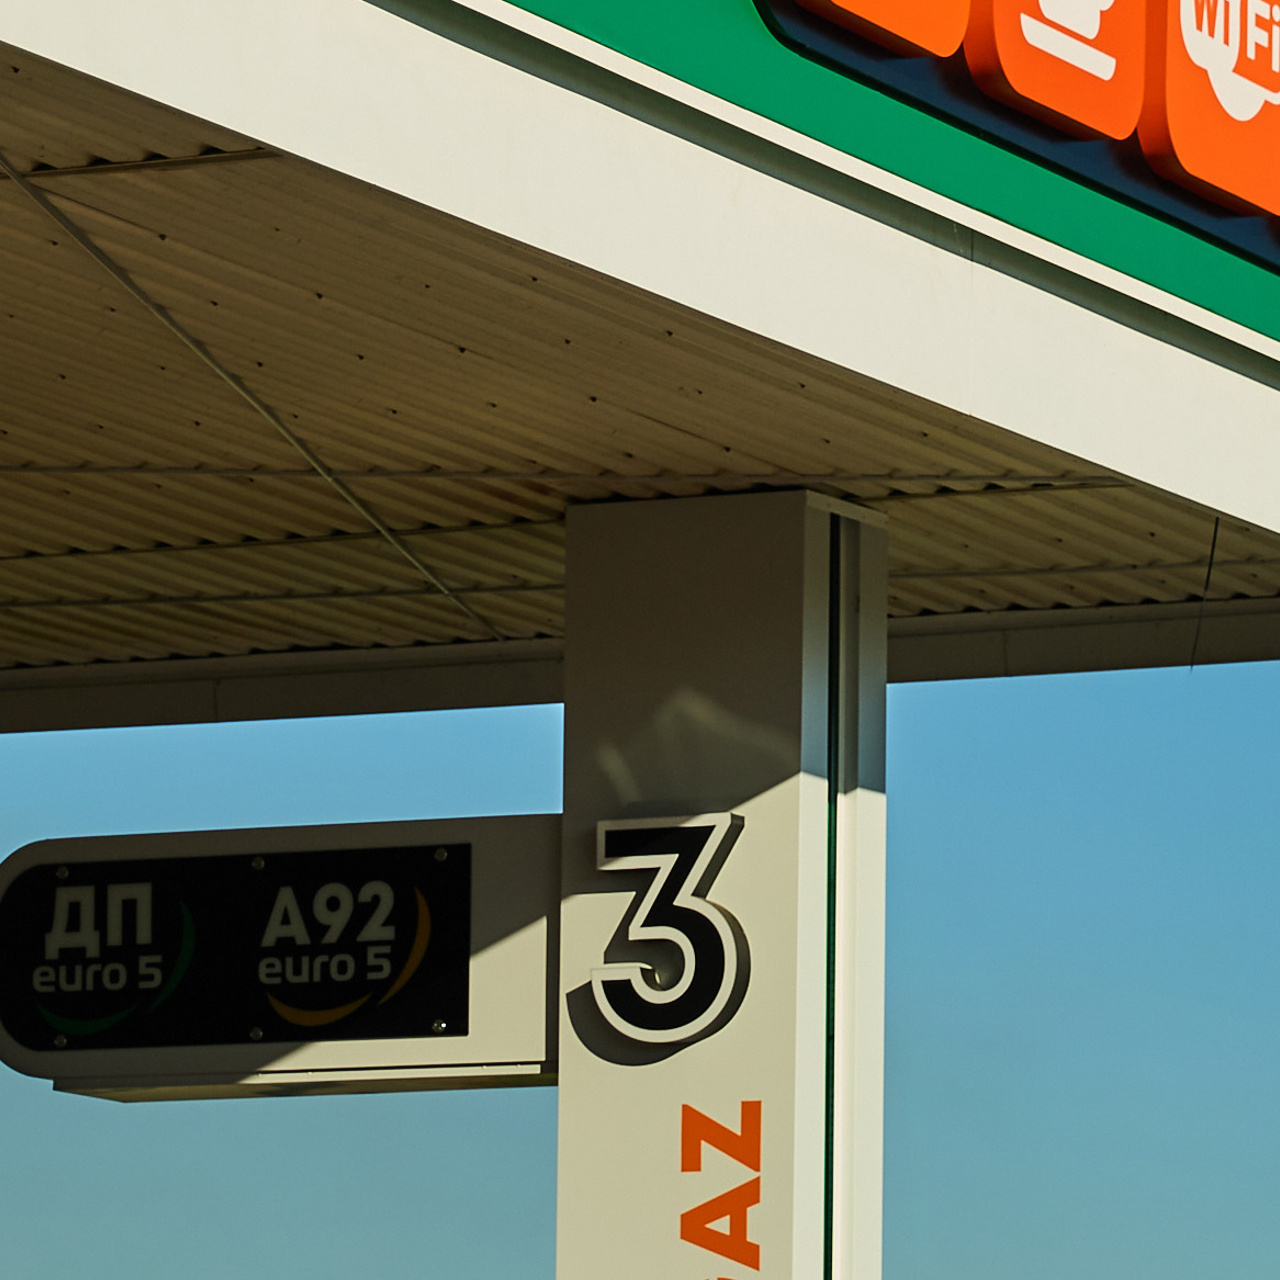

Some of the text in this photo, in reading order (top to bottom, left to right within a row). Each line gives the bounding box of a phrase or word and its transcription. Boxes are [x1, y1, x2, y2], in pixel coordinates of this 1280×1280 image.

[44, 881, 153, 960] ДП
[594, 814, 740, 1042] 3
[32, 954, 163, 993] euro 5
[258, 945, 392, 984] euro 5
[680, 1100, 762, 1280] AZ
